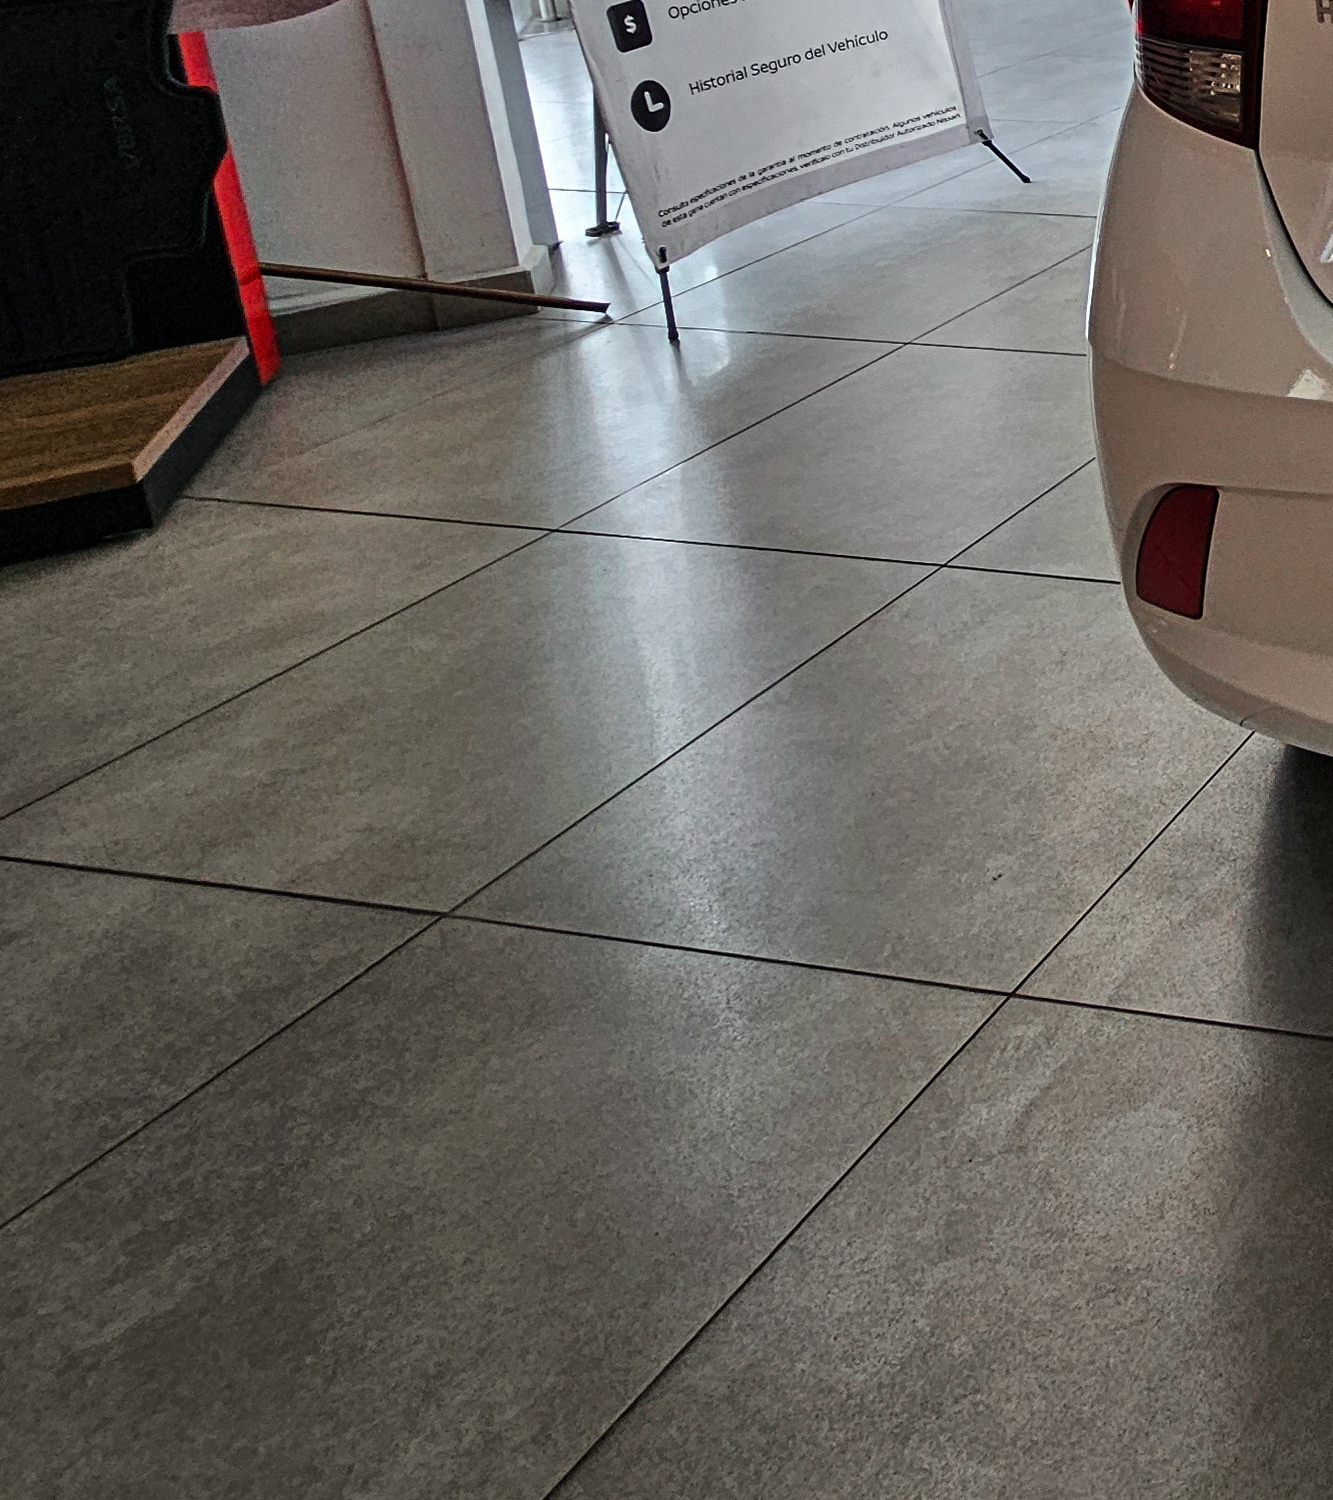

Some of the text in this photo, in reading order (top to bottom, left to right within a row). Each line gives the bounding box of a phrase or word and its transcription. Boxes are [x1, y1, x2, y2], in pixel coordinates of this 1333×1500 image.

[689, 29, 889, 95] Historial Seguro del Vehículo
